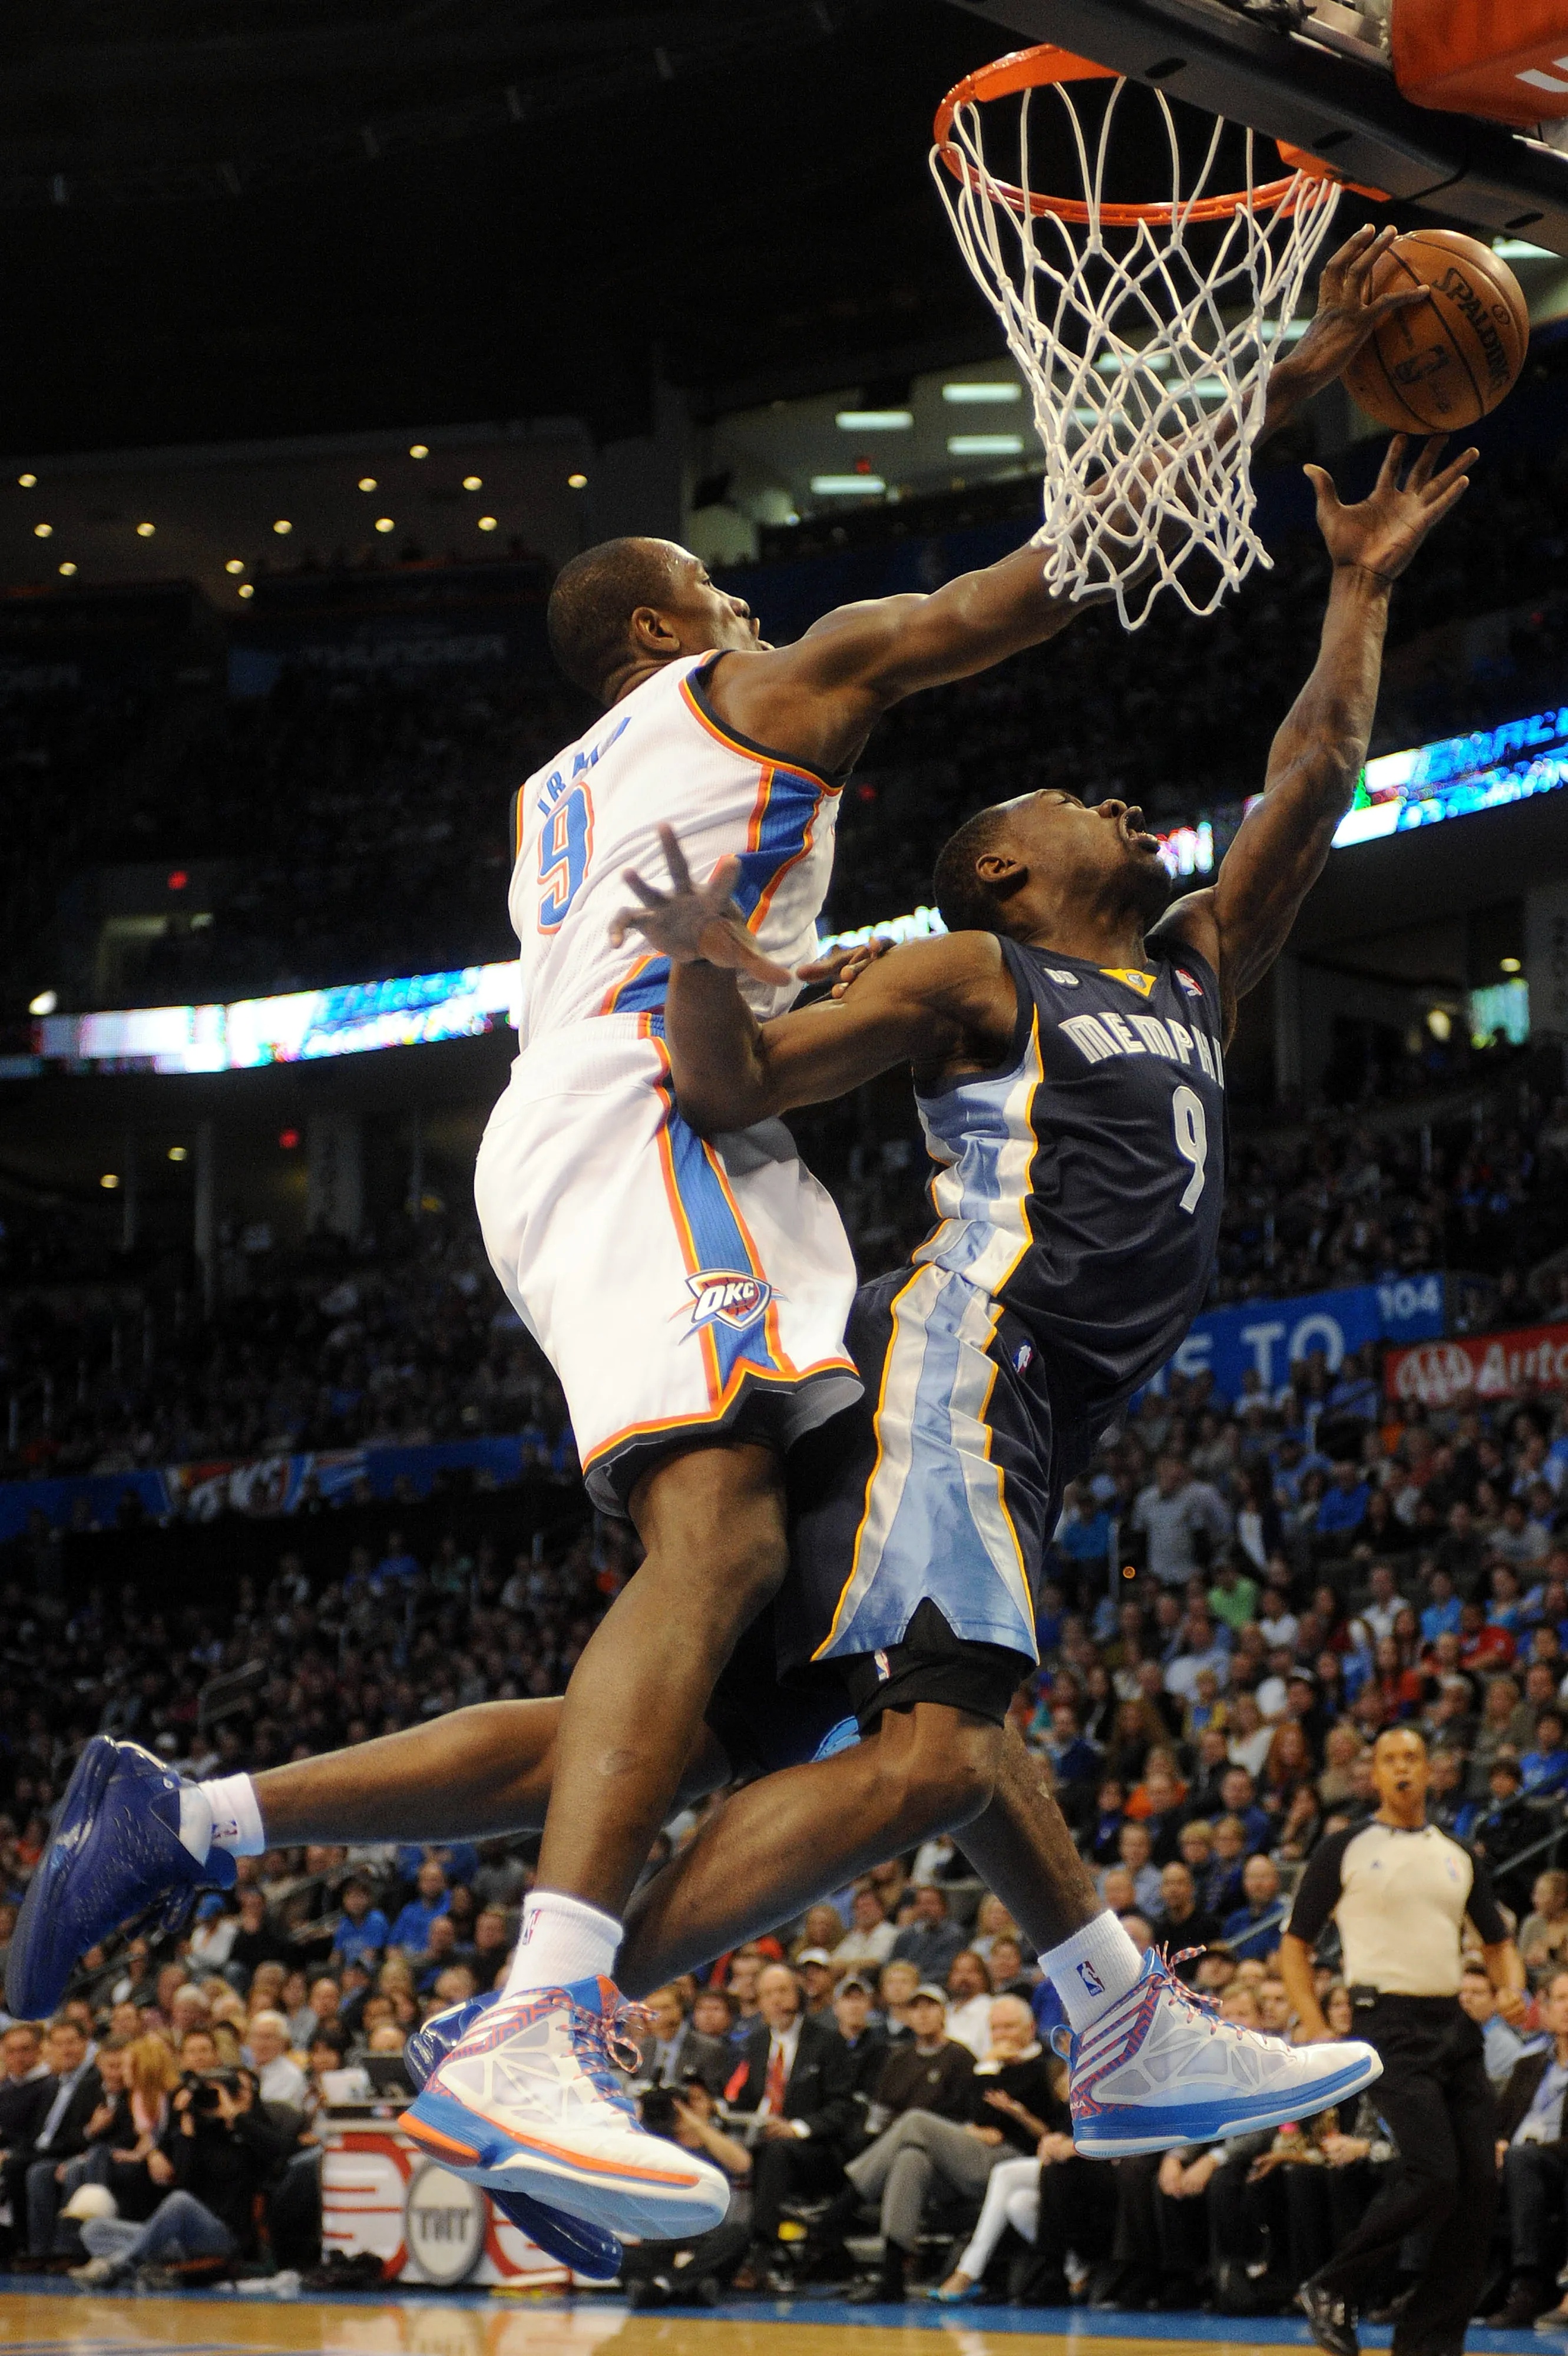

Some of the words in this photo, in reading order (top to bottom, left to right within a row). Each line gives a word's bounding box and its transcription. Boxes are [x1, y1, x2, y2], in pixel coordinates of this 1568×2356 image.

[537, 781, 594, 935] 9
[1172, 1086, 1208, 1215] 9
[693, 1281, 755, 1321] OKC
[1377, 1276, 1439, 1322] 104
